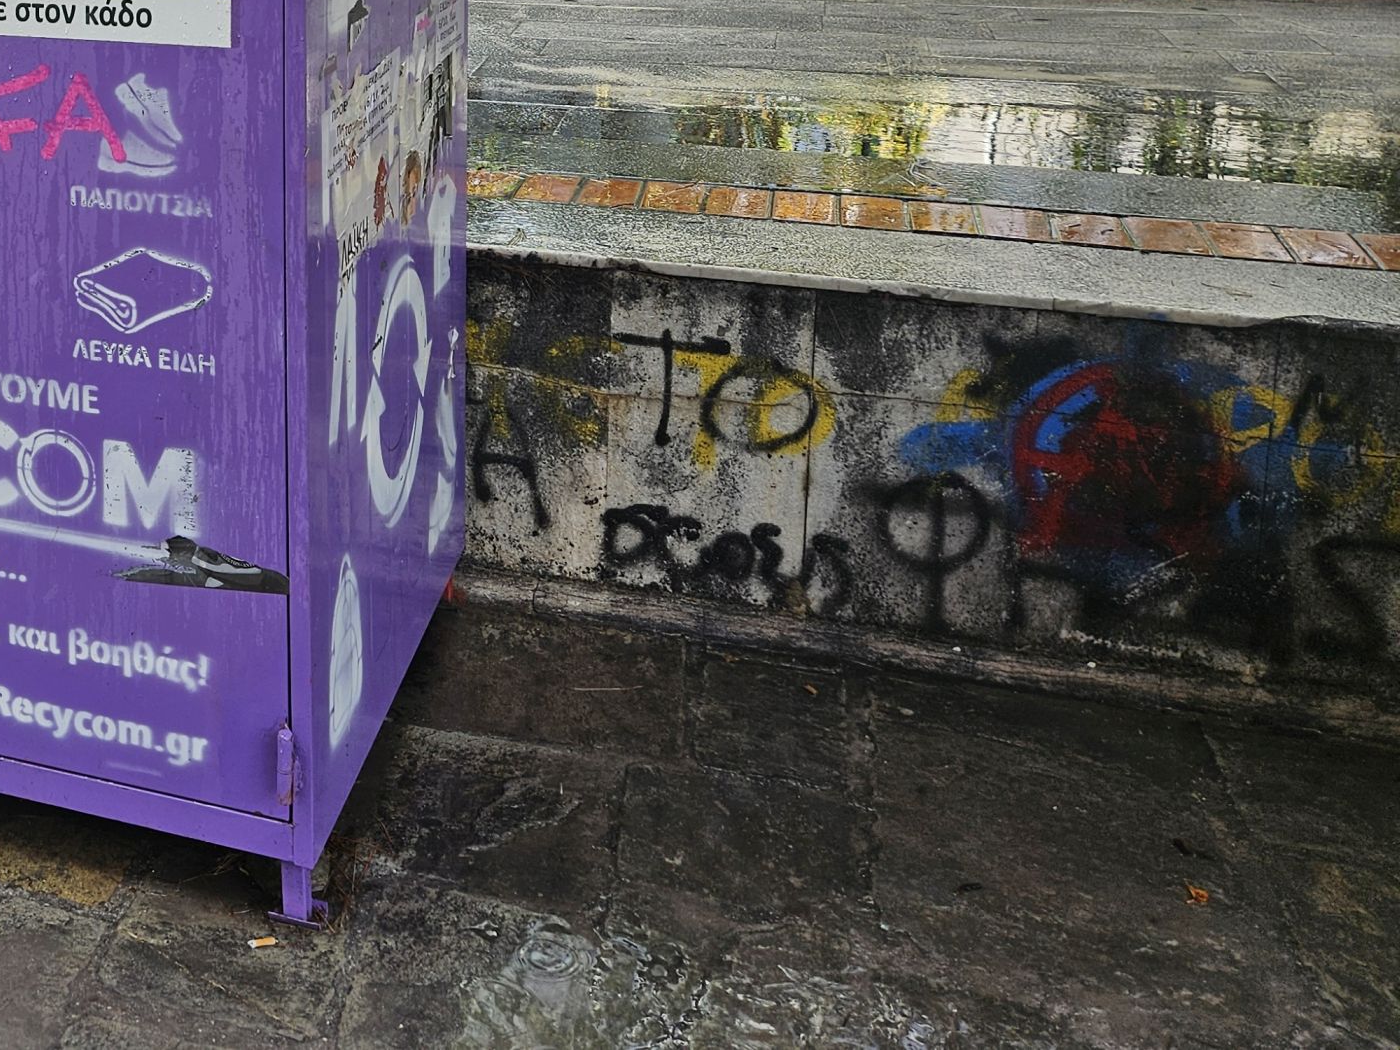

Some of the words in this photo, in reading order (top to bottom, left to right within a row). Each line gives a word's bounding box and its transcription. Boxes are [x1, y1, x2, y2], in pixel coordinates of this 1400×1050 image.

[15, 3, 76, 25] στον
[70, 185, 213, 219] ΠΑΠΟΥΤΣΙΑ
[72, 338, 152, 369] ΛΕΥΚΑ
[159, 349, 216, 376] ΕΙΔΗ
[8, 622, 60, 656] και
[68, 629, 210, 693] βοηθάς!
